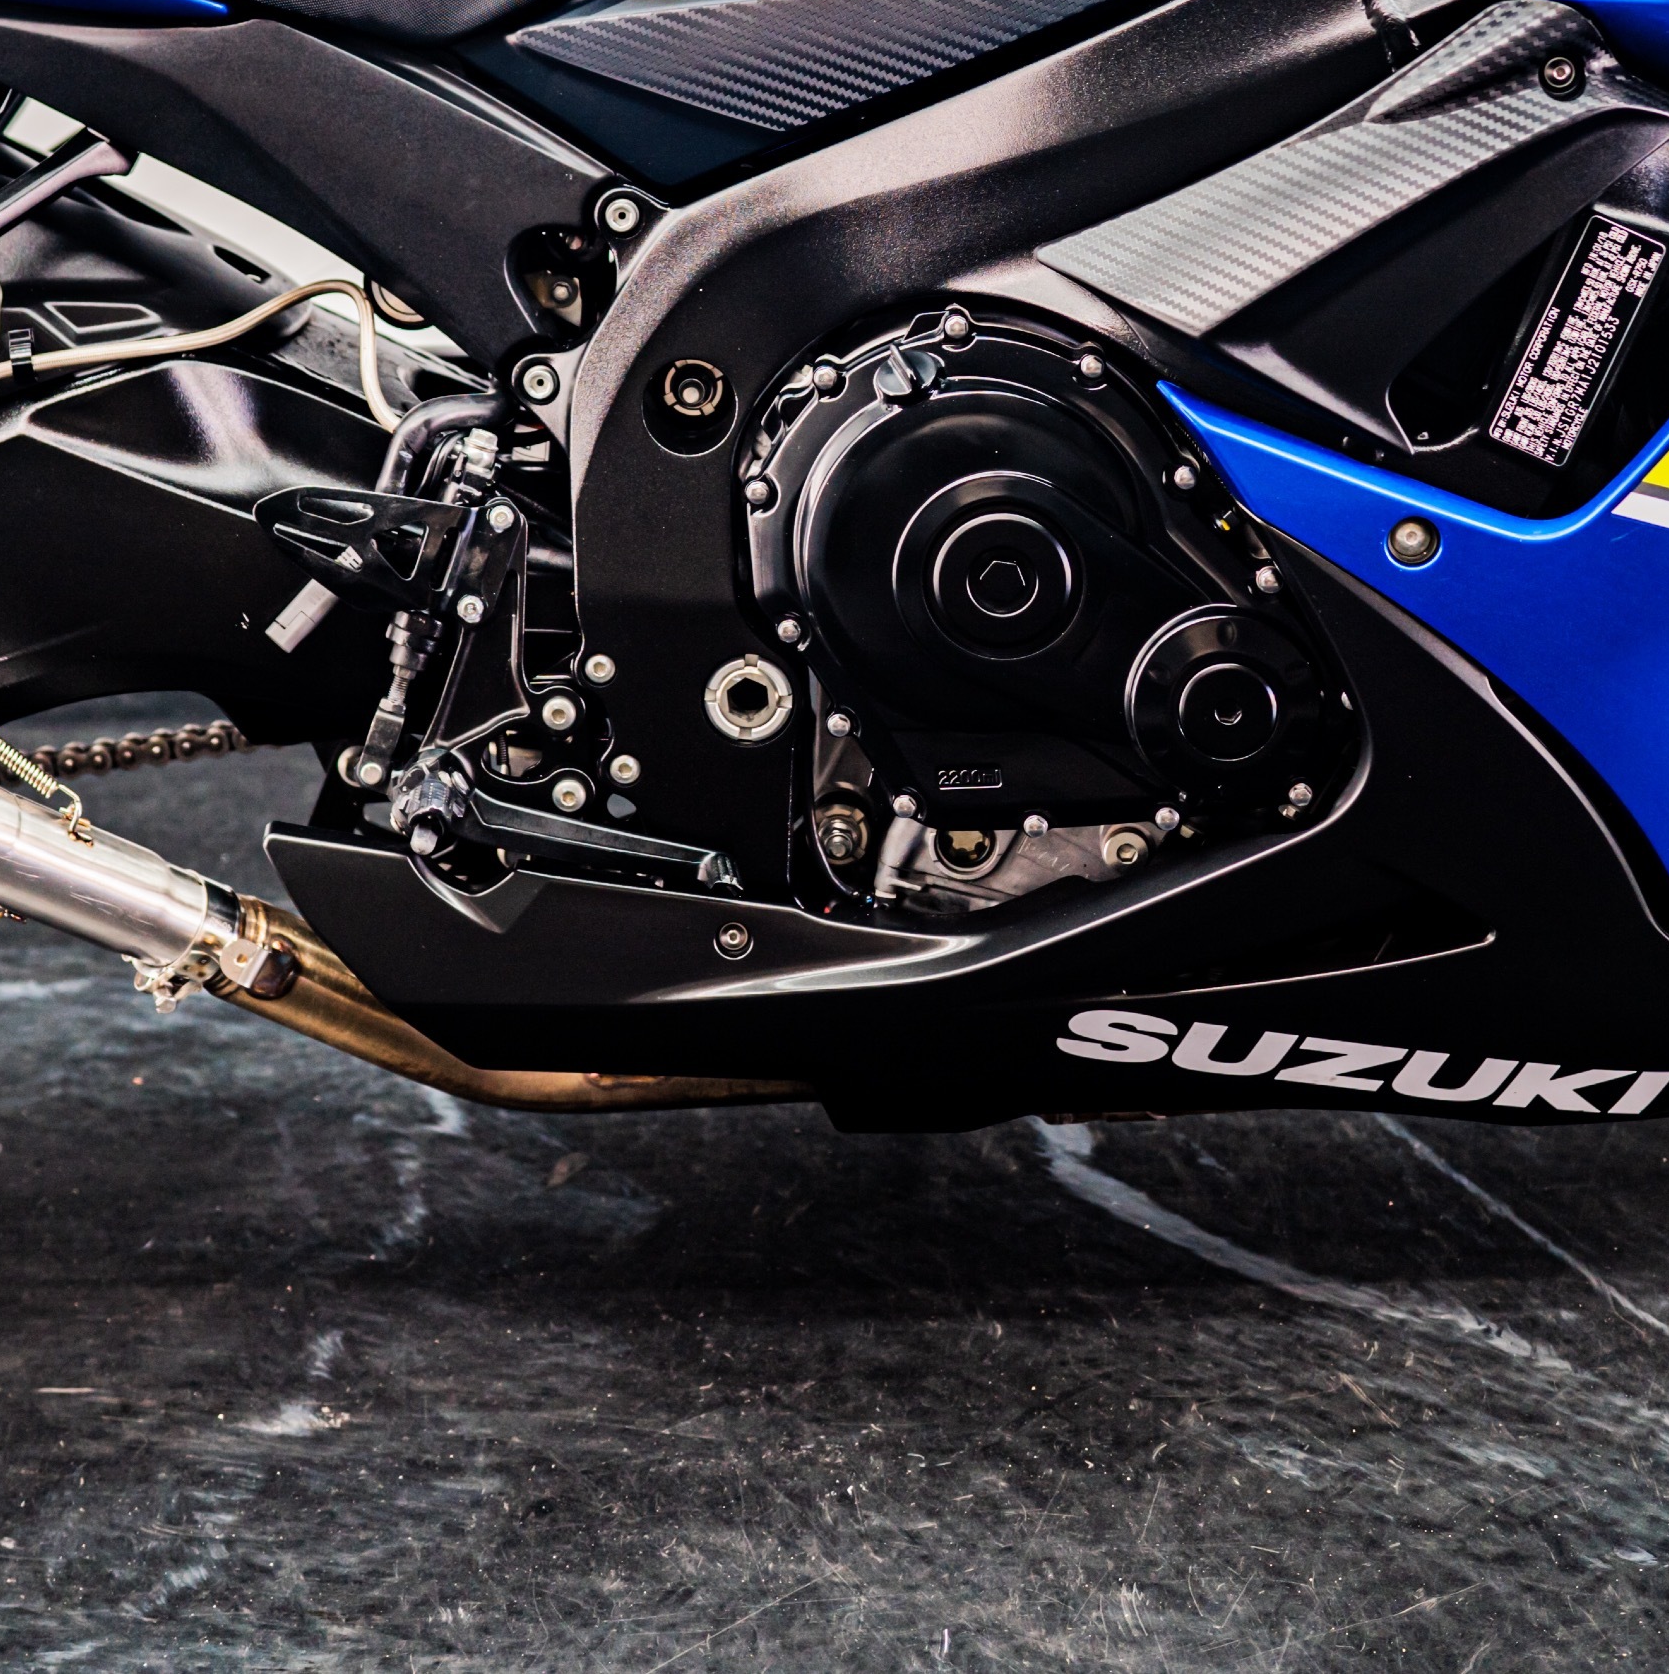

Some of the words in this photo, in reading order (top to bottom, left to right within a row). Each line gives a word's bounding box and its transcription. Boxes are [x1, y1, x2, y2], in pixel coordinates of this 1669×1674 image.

[1500, 389, 1521, 419] SUZUKI
[1514, 360, 1534, 388] MOTOR
[1527, 305, 1561, 361] CORPORATION
